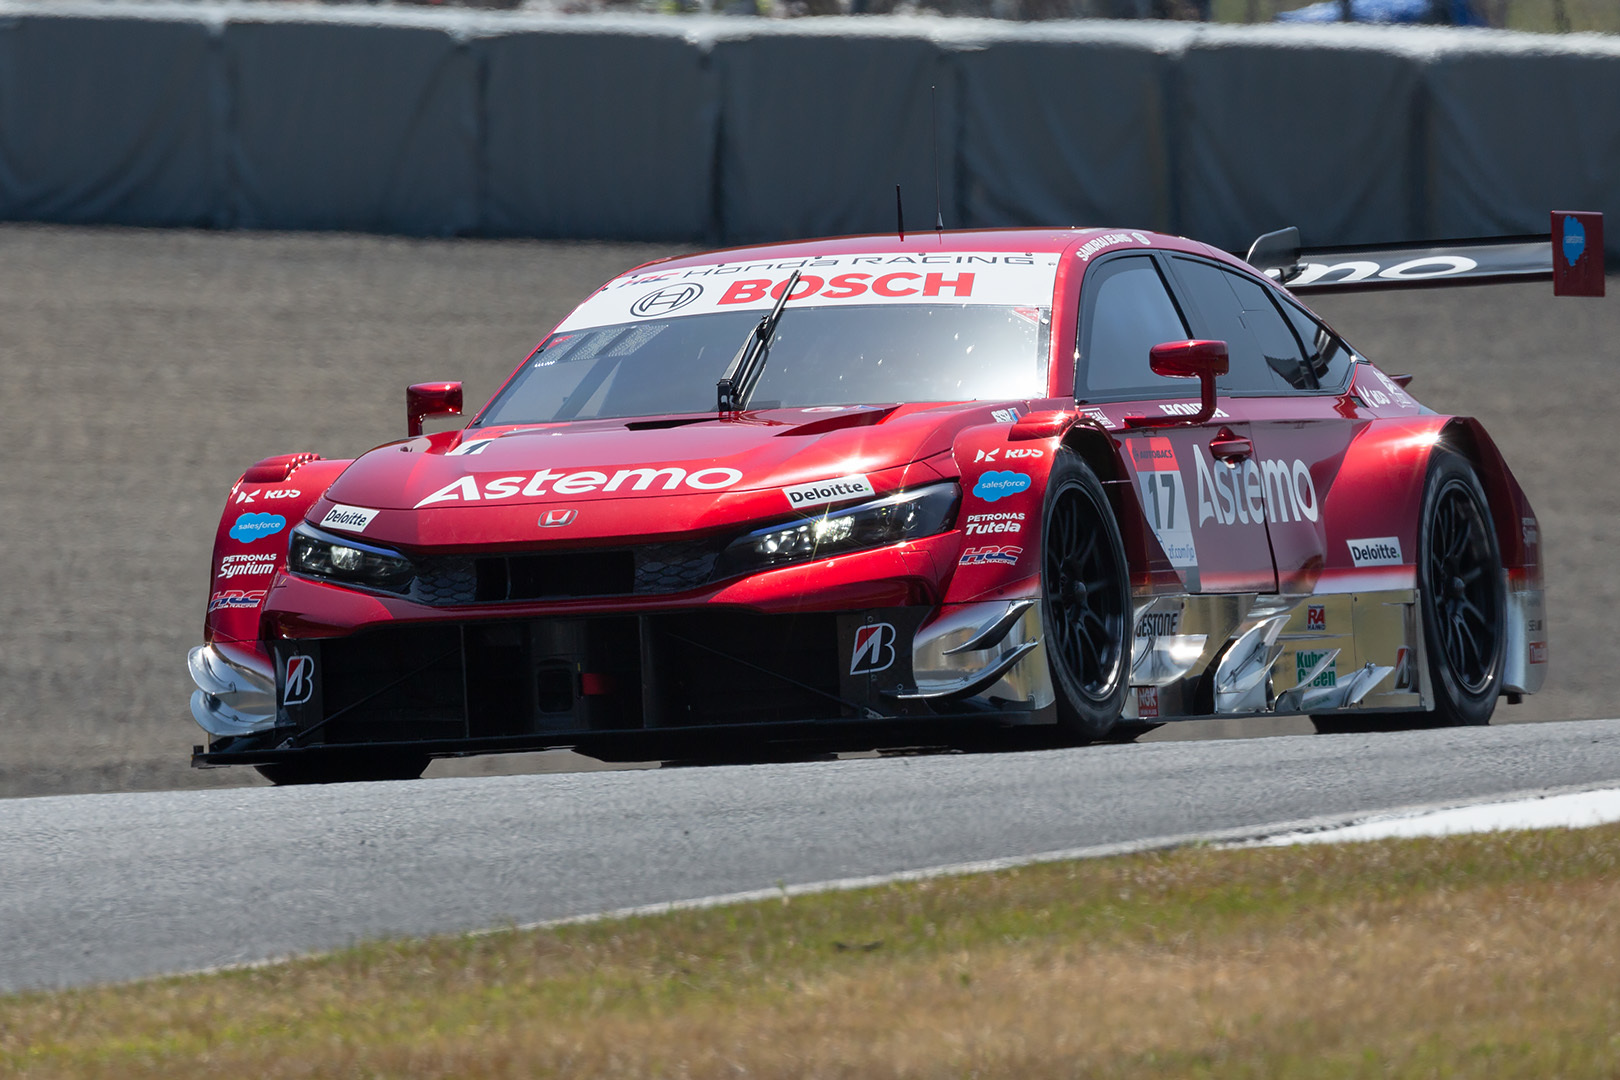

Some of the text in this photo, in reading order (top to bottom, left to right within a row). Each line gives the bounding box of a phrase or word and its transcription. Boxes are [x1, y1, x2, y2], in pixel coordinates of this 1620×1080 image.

[682, 257, 839, 279] Honda
[851, 255, 1034, 265] RACING
[716, 272, 976, 306] BOSCH
[1158, 403, 1230, 418] HONA
[413, 467, 744, 509] Astemo
[981, 480, 1026, 490] salesforce
[1192, 444, 1318, 528] Astemo
[1148, 474, 1176, 530] 17
[238, 521, 281, 531] salesforce
[967, 512, 1026, 523] PETRONAS
[965, 521, 1021, 536] Tutela
[222, 553, 278, 564] PETRONAS
[959, 545, 1024, 562] HRC
[217, 561, 275, 579] Syntium
[208, 589, 268, 611] HRC
[1307, 608, 1325, 625] RA
[1296, 652, 1336, 668] Kuba
[1297, 668, 1336, 688] Geen
